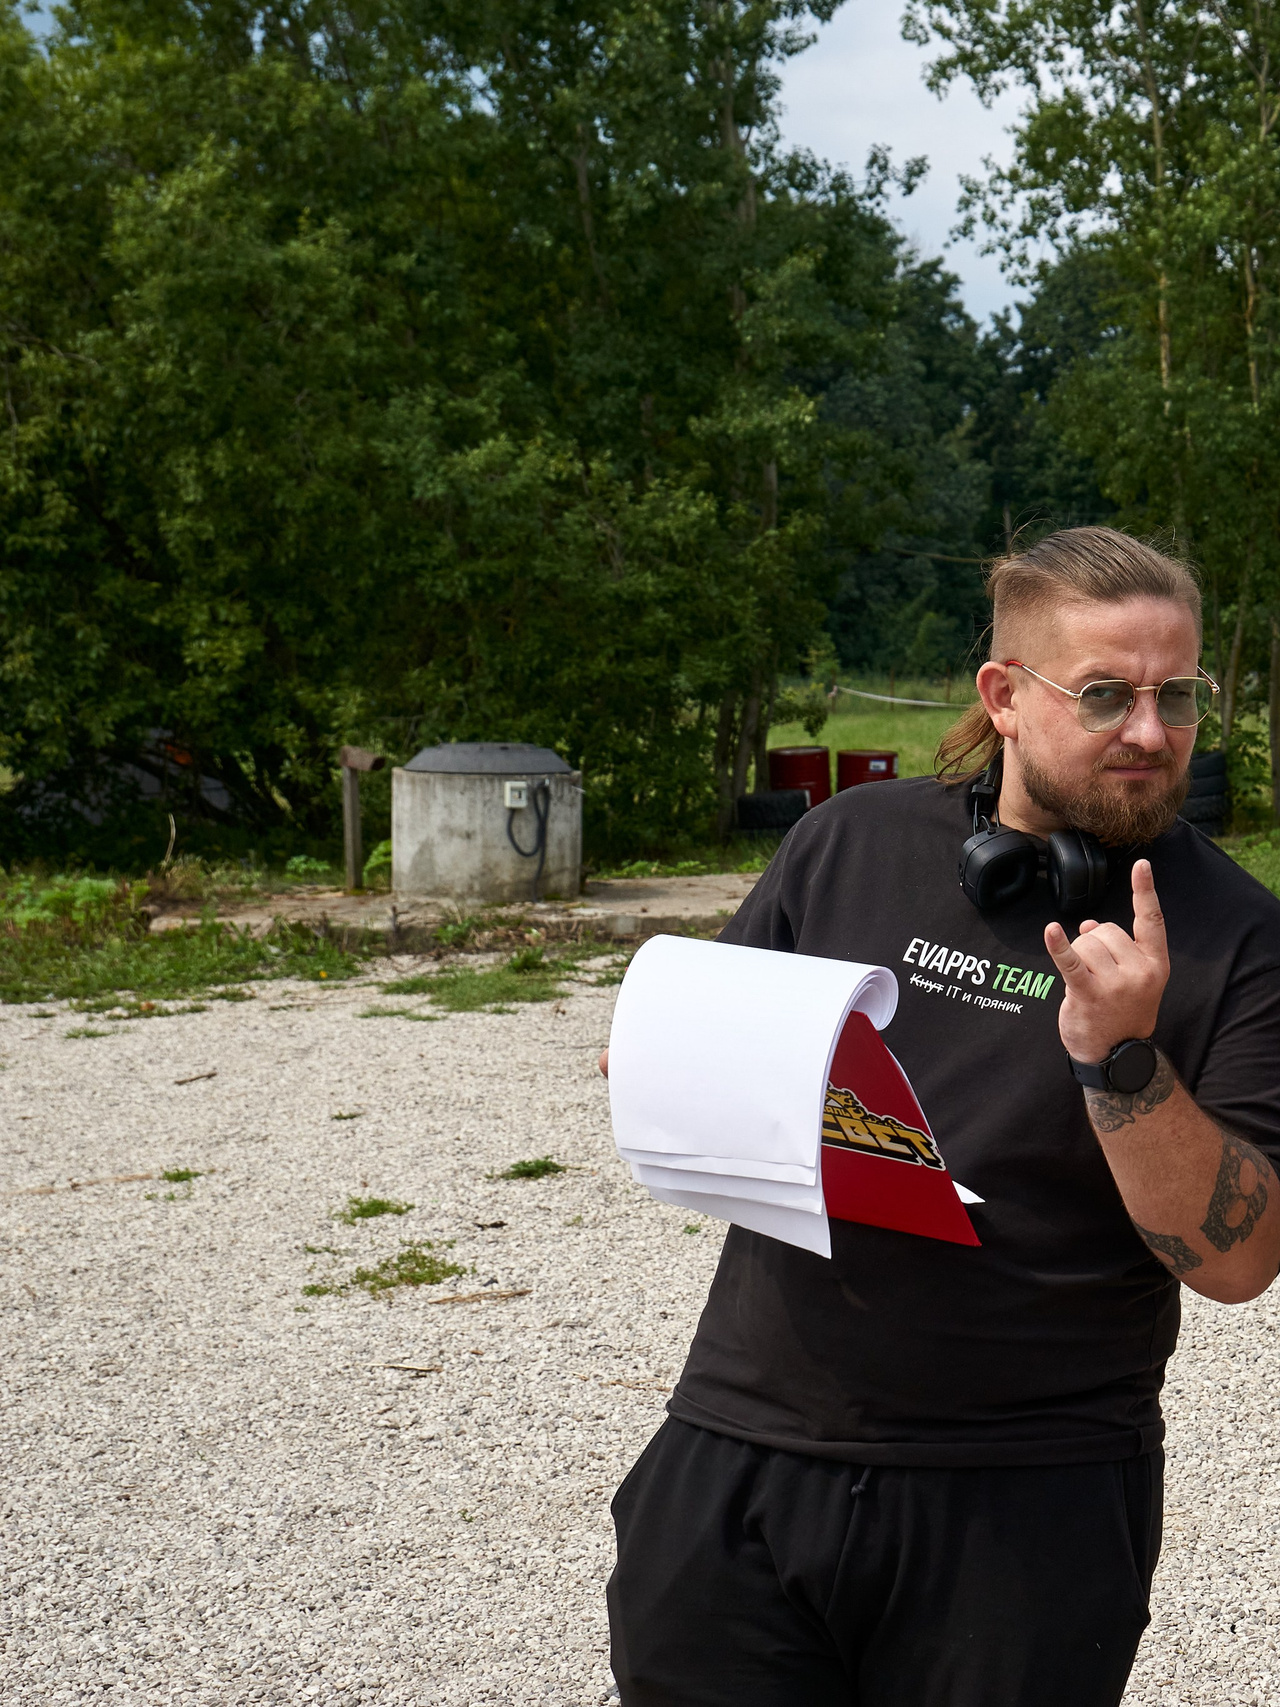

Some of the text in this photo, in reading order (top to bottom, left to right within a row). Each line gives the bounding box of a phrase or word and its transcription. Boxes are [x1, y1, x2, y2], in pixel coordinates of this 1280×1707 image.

[902, 937, 1056, 1001] EVAPPS TEAM
[945, 984, 963, 999] IT
[962, 991, 972, 1004] и
[973, 994, 1024, 1015] пряник
